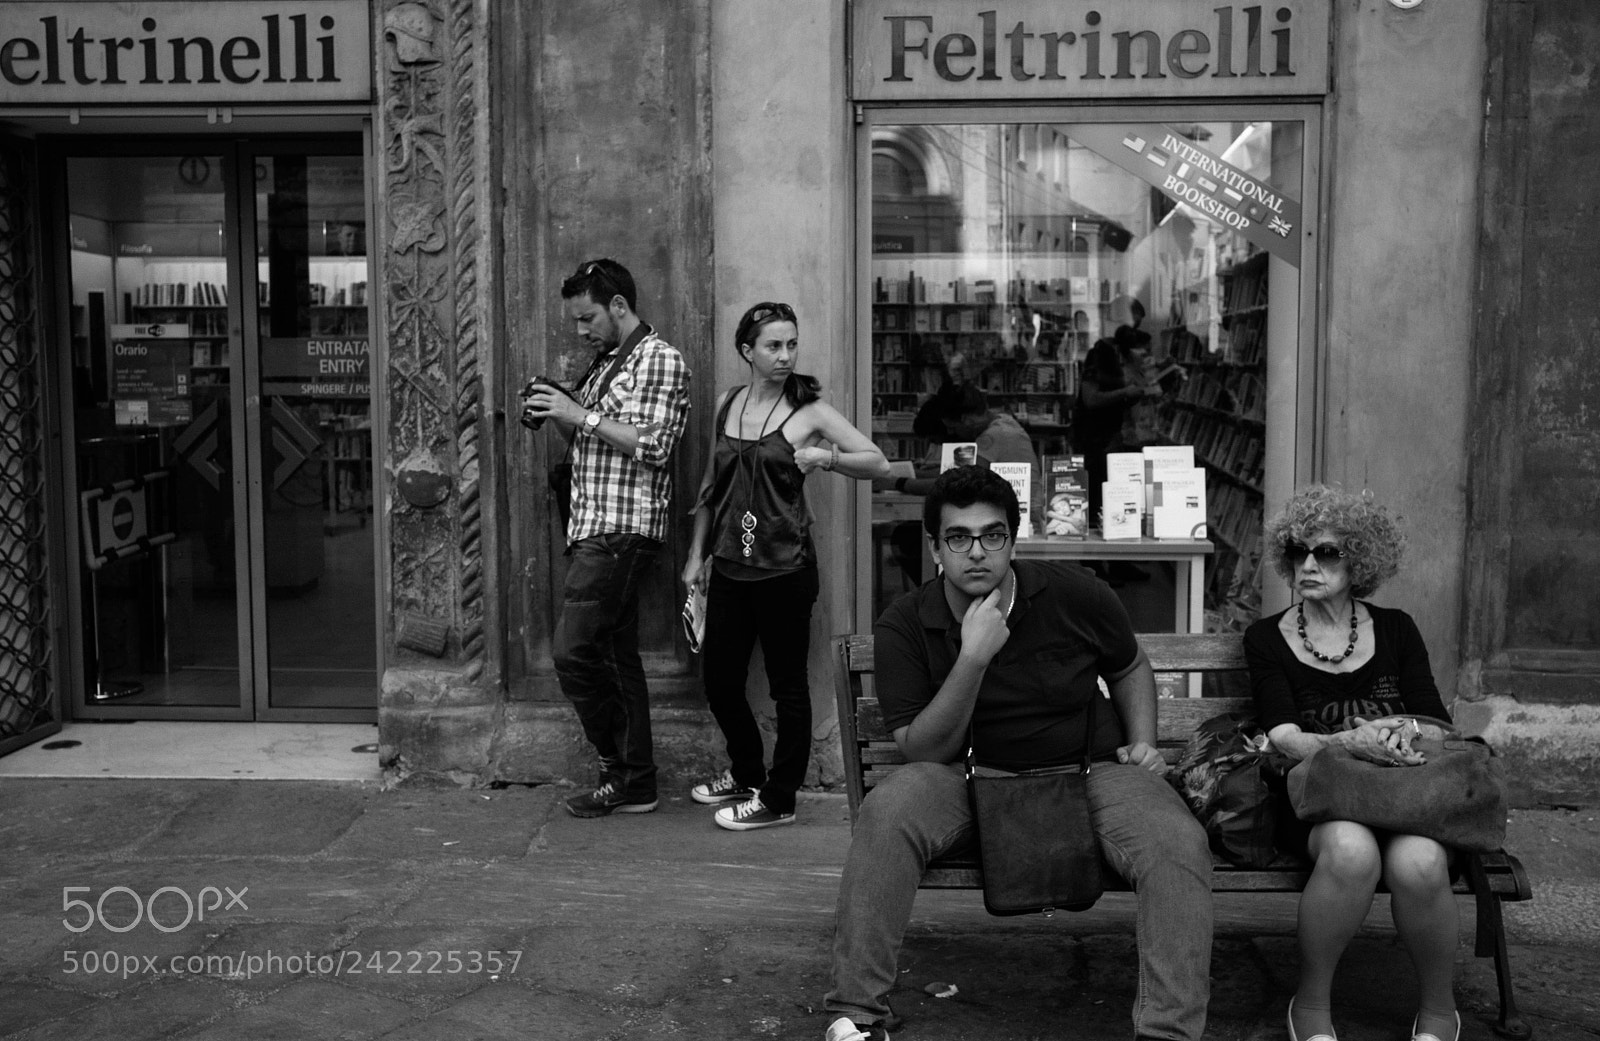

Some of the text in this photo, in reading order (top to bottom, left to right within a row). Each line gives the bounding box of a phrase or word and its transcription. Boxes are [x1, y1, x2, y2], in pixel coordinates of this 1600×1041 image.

[0, 14, 342, 85] eltrinelli
[883, 6, 1296, 82] Feltrinelli
[1161, 134, 1284, 214] INTERNATIONAL
[1162, 175, 1250, 231] BOOKSHOP
[114, 344, 148, 356] Orario
[307, 340, 370, 356] ENTRATA
[319, 359, 365, 374] ENTRY
[301, 384, 347, 394] SPINGERE
[349, 384, 354, 395] /
[993, 466, 1027, 475] ZYGMUNT
